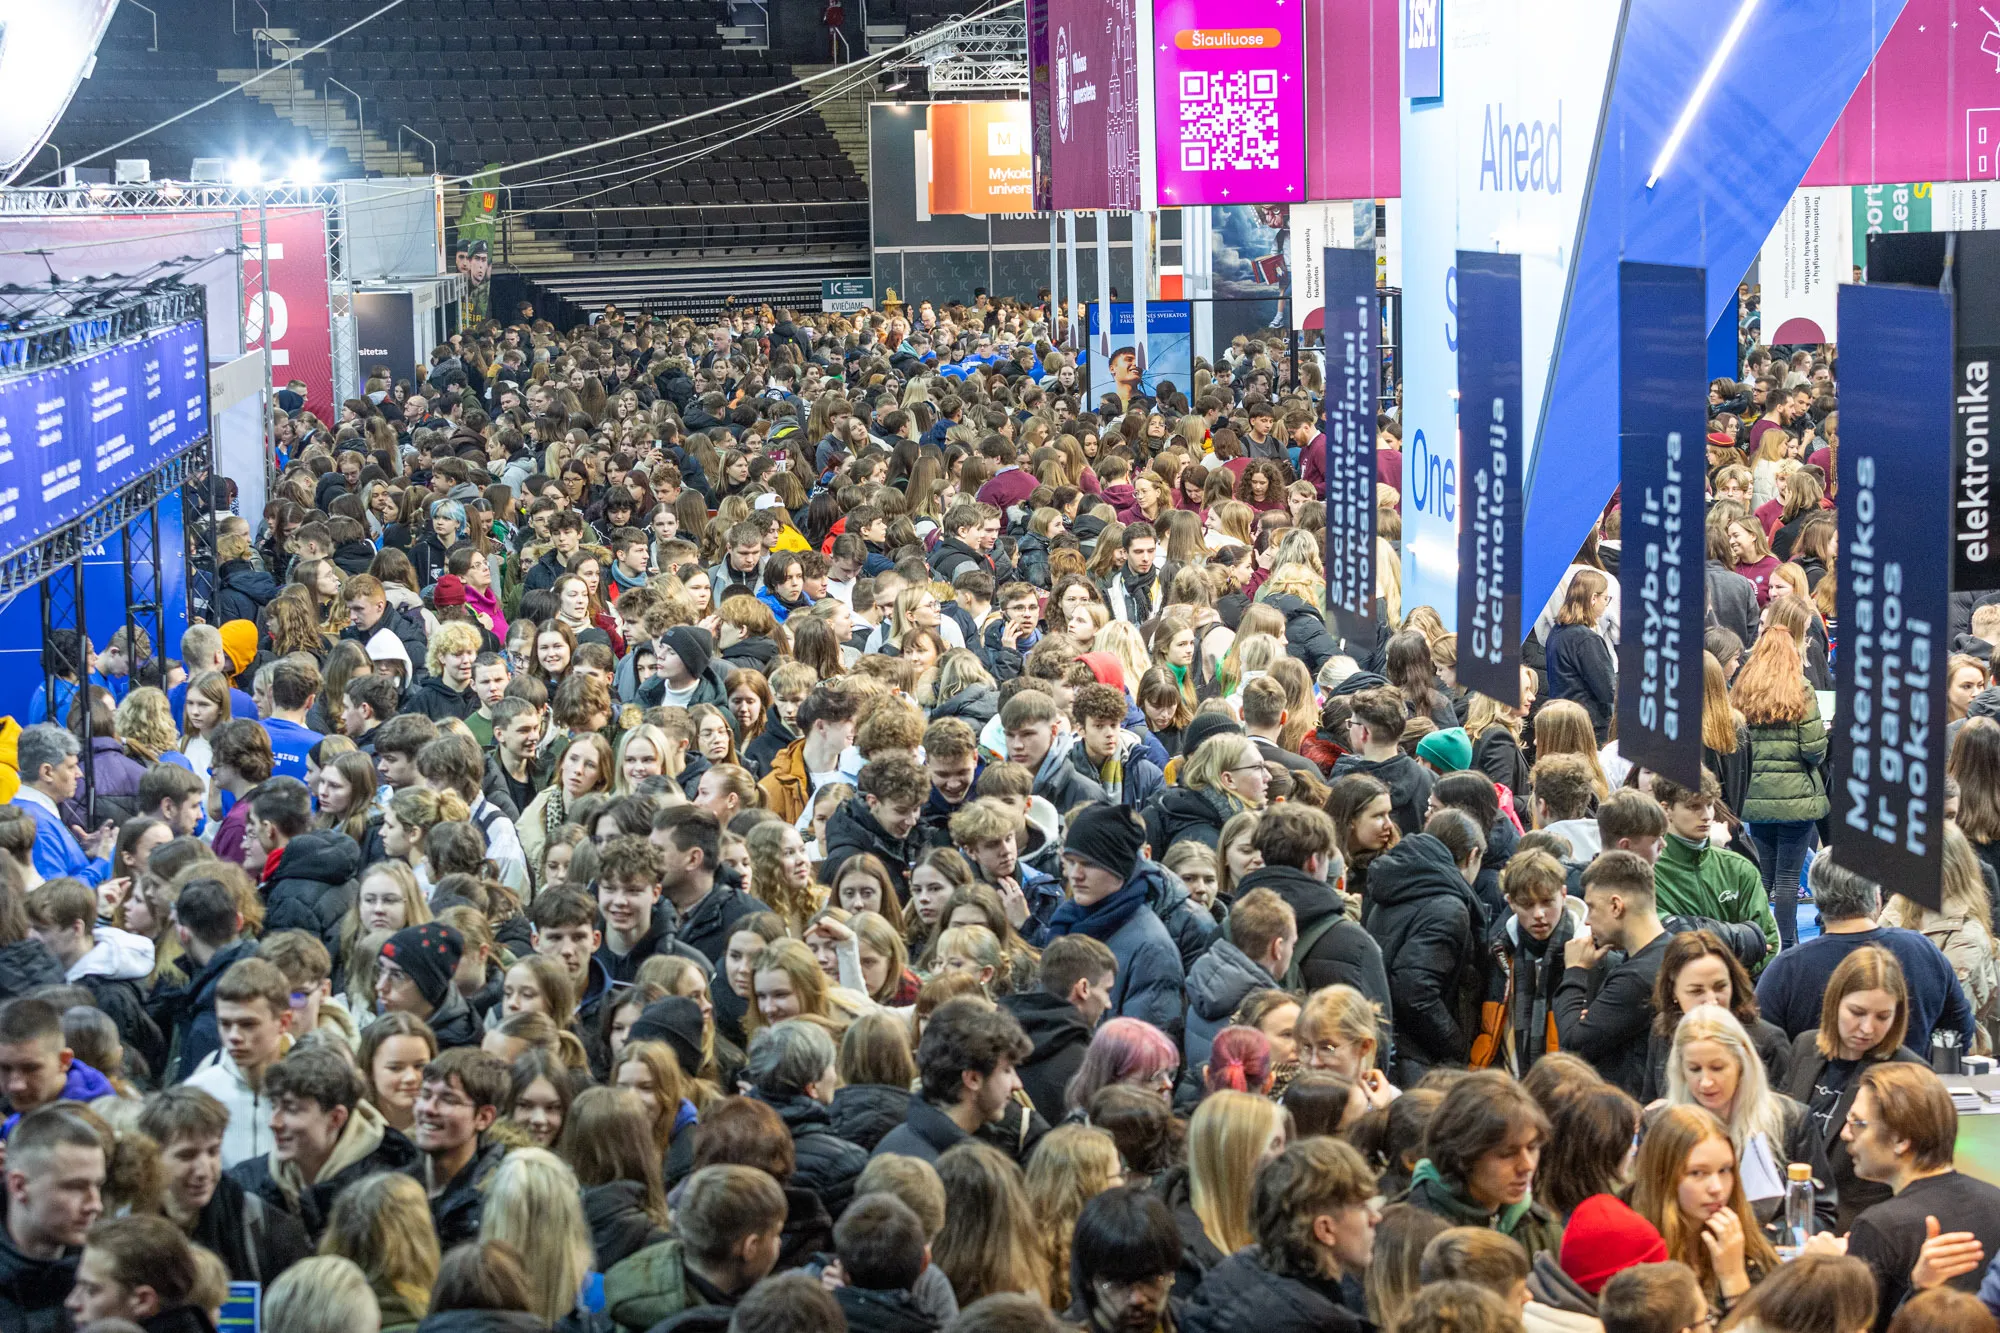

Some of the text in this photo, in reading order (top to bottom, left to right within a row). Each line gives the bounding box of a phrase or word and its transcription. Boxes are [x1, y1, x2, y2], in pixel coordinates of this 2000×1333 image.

[1191, 29, 1265, 48] Šiauliuose
[1408, 0, 1437, 49] ISM
[988, 167, 1033, 182] Mykolo
[988, 182, 1033, 195] univers
[1479, 99, 1562, 194] Ahead
[1803, 196, 1812, 229] politikos
[1888, 183, 1909, 233] Lea
[1980, 189, 1988, 231] Ekonomiko
[830, 282, 842, 295] IC
[831, 300, 865, 311] KVIEČIAME
[1804, 258, 1812, 295] institutas
[358, 347, 389, 356] sitetas
[1343, 331, 1356, 613] humanitariniai
[1355, 295, 1369, 618] mokslai ir menai
[1411, 428, 1456, 522] One
[1957, 361, 1989, 562] elektronika
[1472, 468, 1488, 659] Cheminė
[1488, 397, 1508, 664] technologija
[1639, 487, 1662, 731] Statyba ir
[1660, 431, 1682, 740] architektūra
[1846, 457, 1875, 831] Matematikos
[1873, 563, 1903, 843] ir gamtos
[1903, 619, 1930, 855] mokslai
